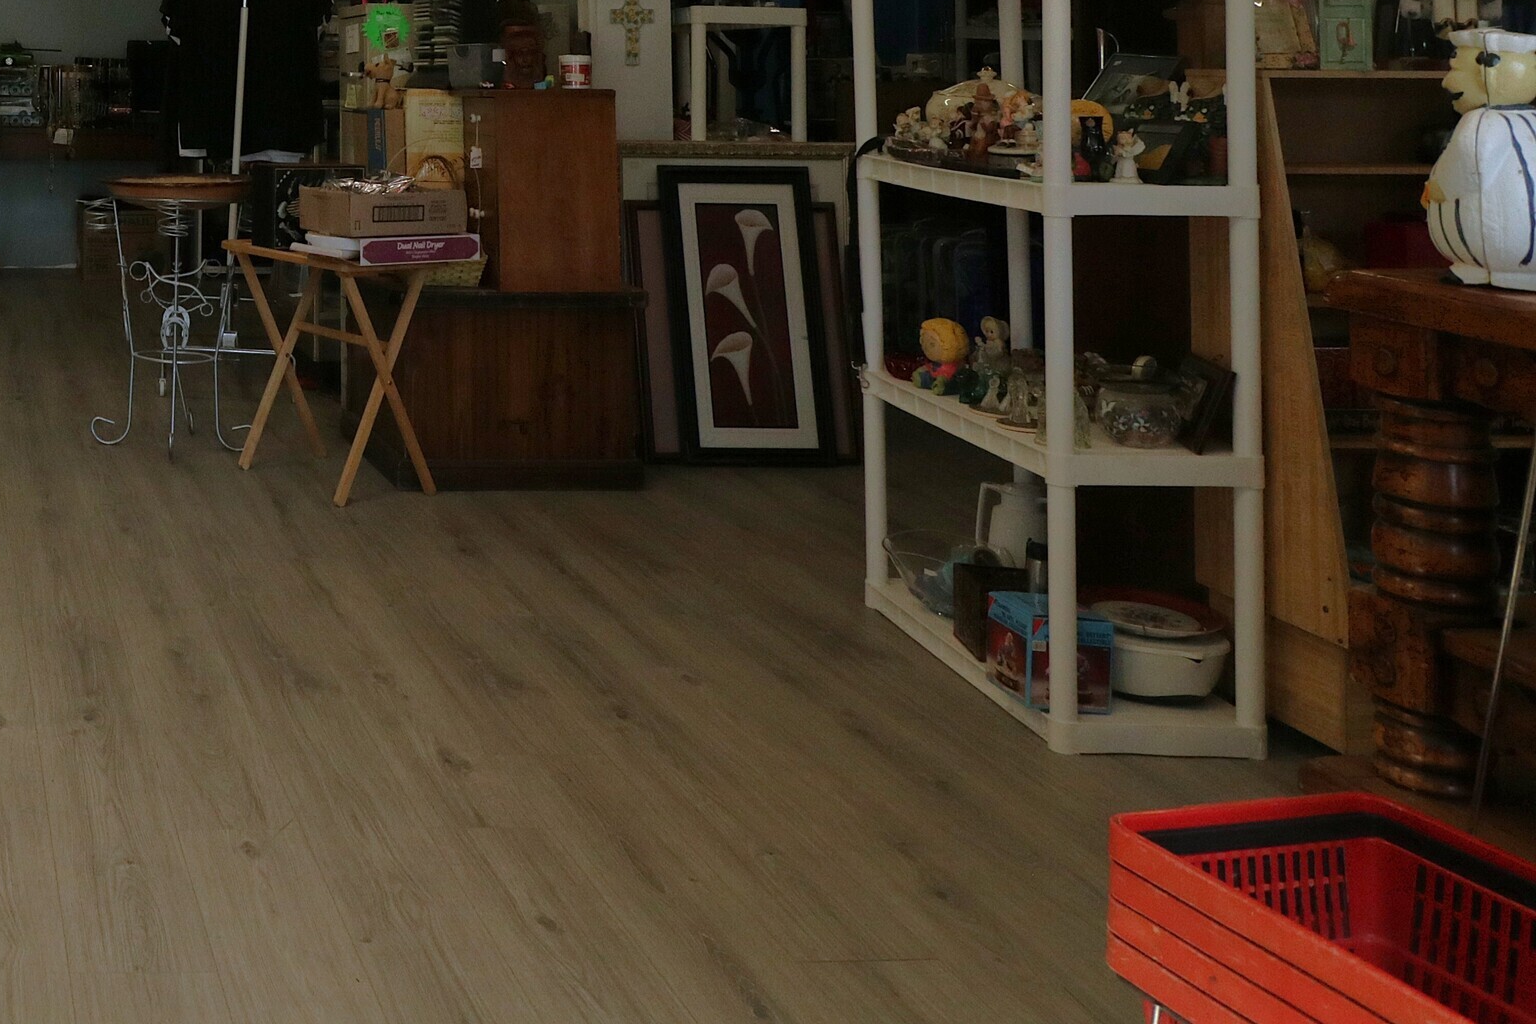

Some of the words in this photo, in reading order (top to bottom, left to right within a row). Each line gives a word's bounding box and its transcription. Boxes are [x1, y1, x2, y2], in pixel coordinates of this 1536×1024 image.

[397, 242, 413, 251] Dual
[413, 242, 426, 250] Nail
[426, 241, 446, 252] Dryer
